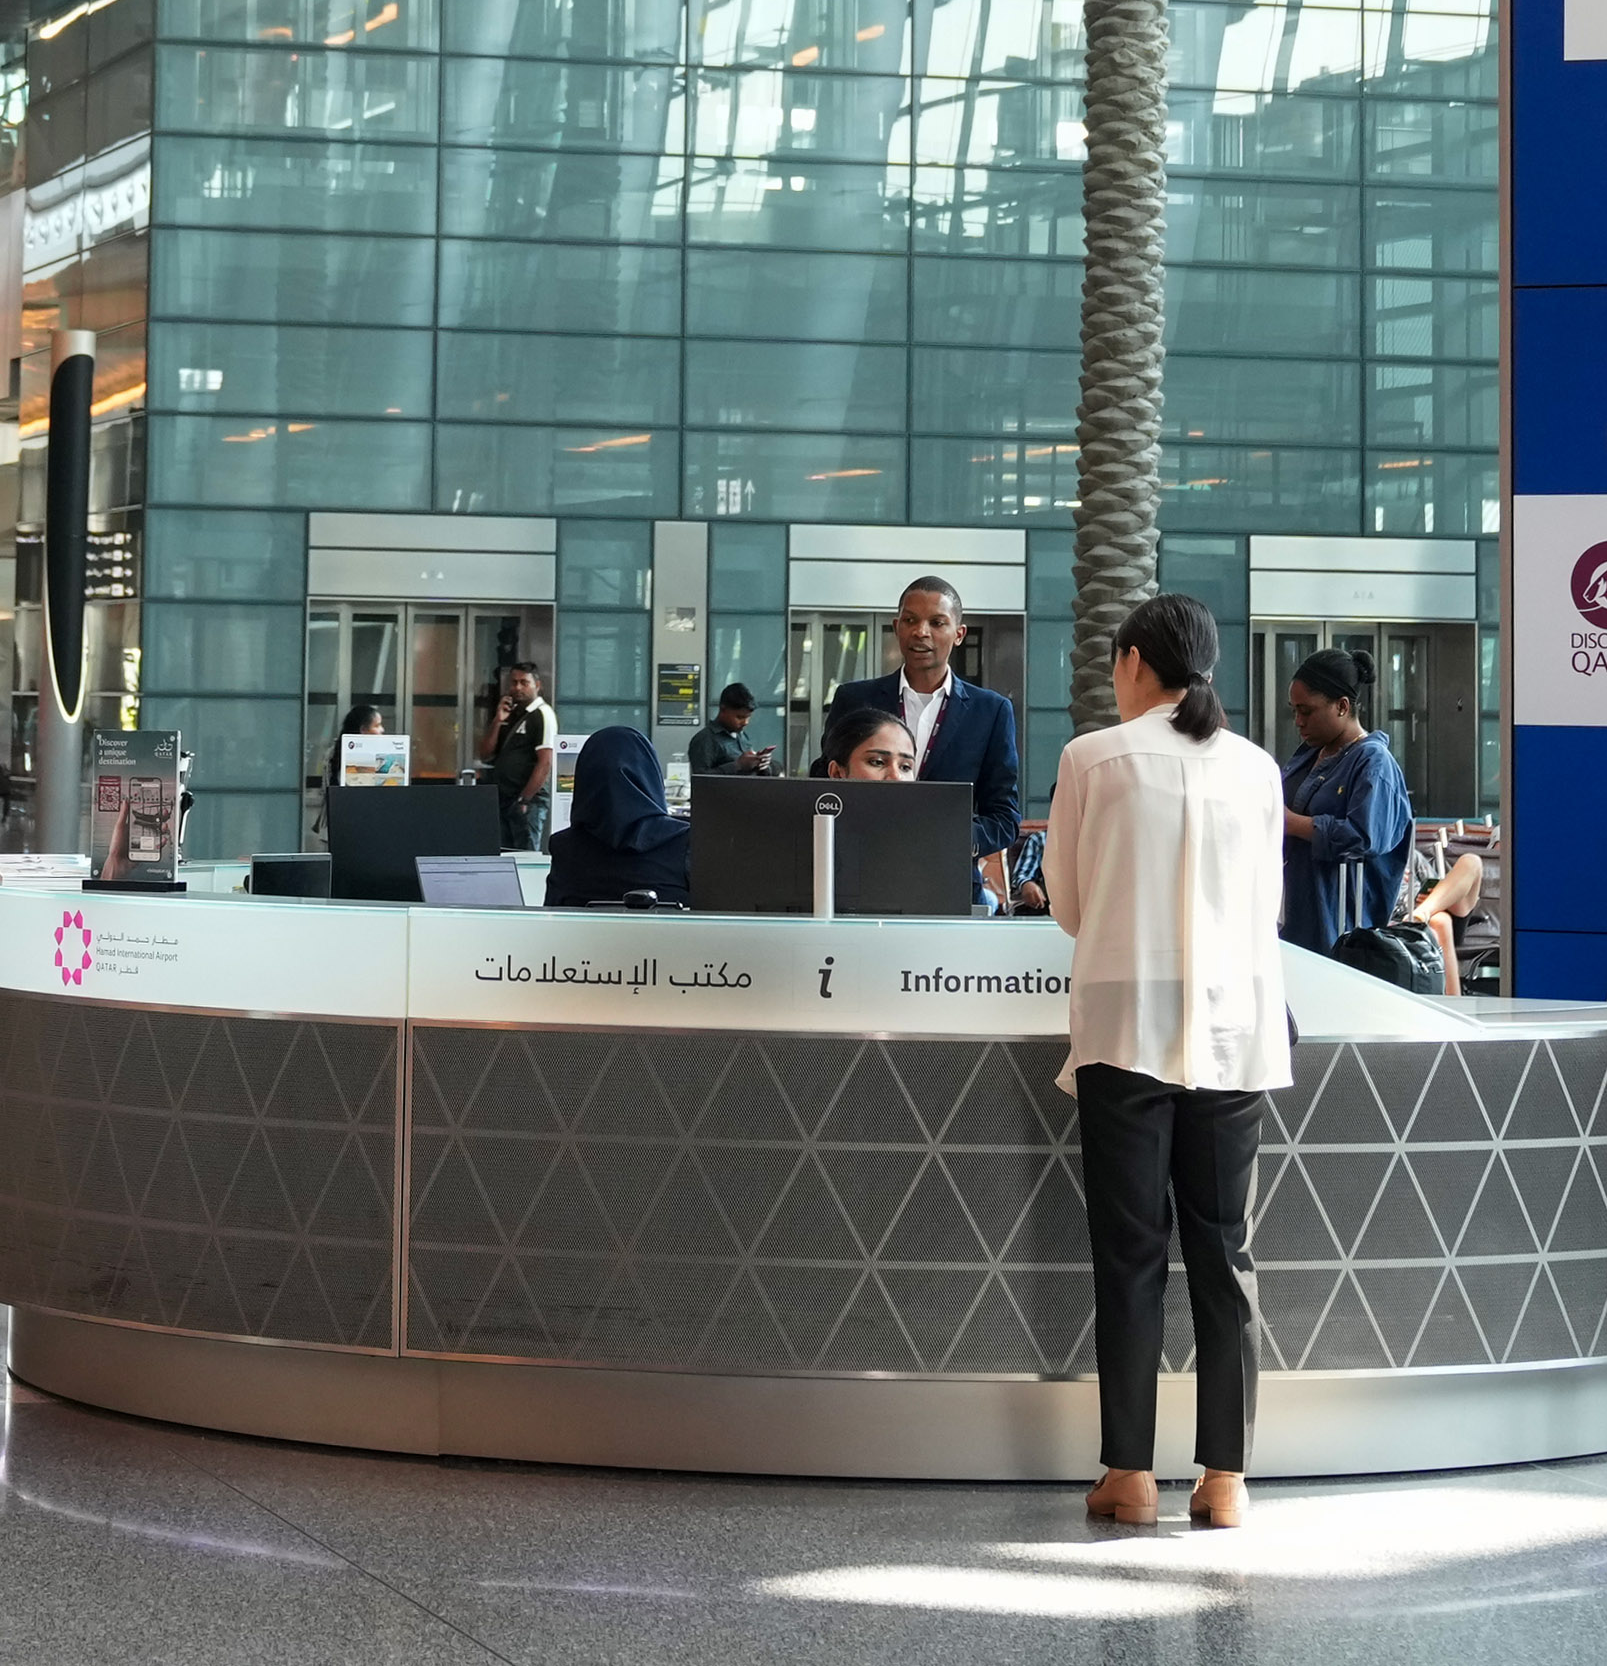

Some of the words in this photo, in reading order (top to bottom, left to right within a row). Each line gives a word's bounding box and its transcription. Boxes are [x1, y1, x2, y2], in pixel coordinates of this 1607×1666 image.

[98, 738, 129, 747] Discover
[104, 749, 127, 758] unique
[98, 756, 137, 766] destination
[819, 802, 840, 811] DELL
[96, 947, 116, 957] Hamad
[116, 948, 155, 960] International
[155, 951, 178, 962] Airport
[96, 962, 117, 973] QATAR
[475, 954, 657, 995] الإستعلامات
[669, 961, 752, 994] مكتب
